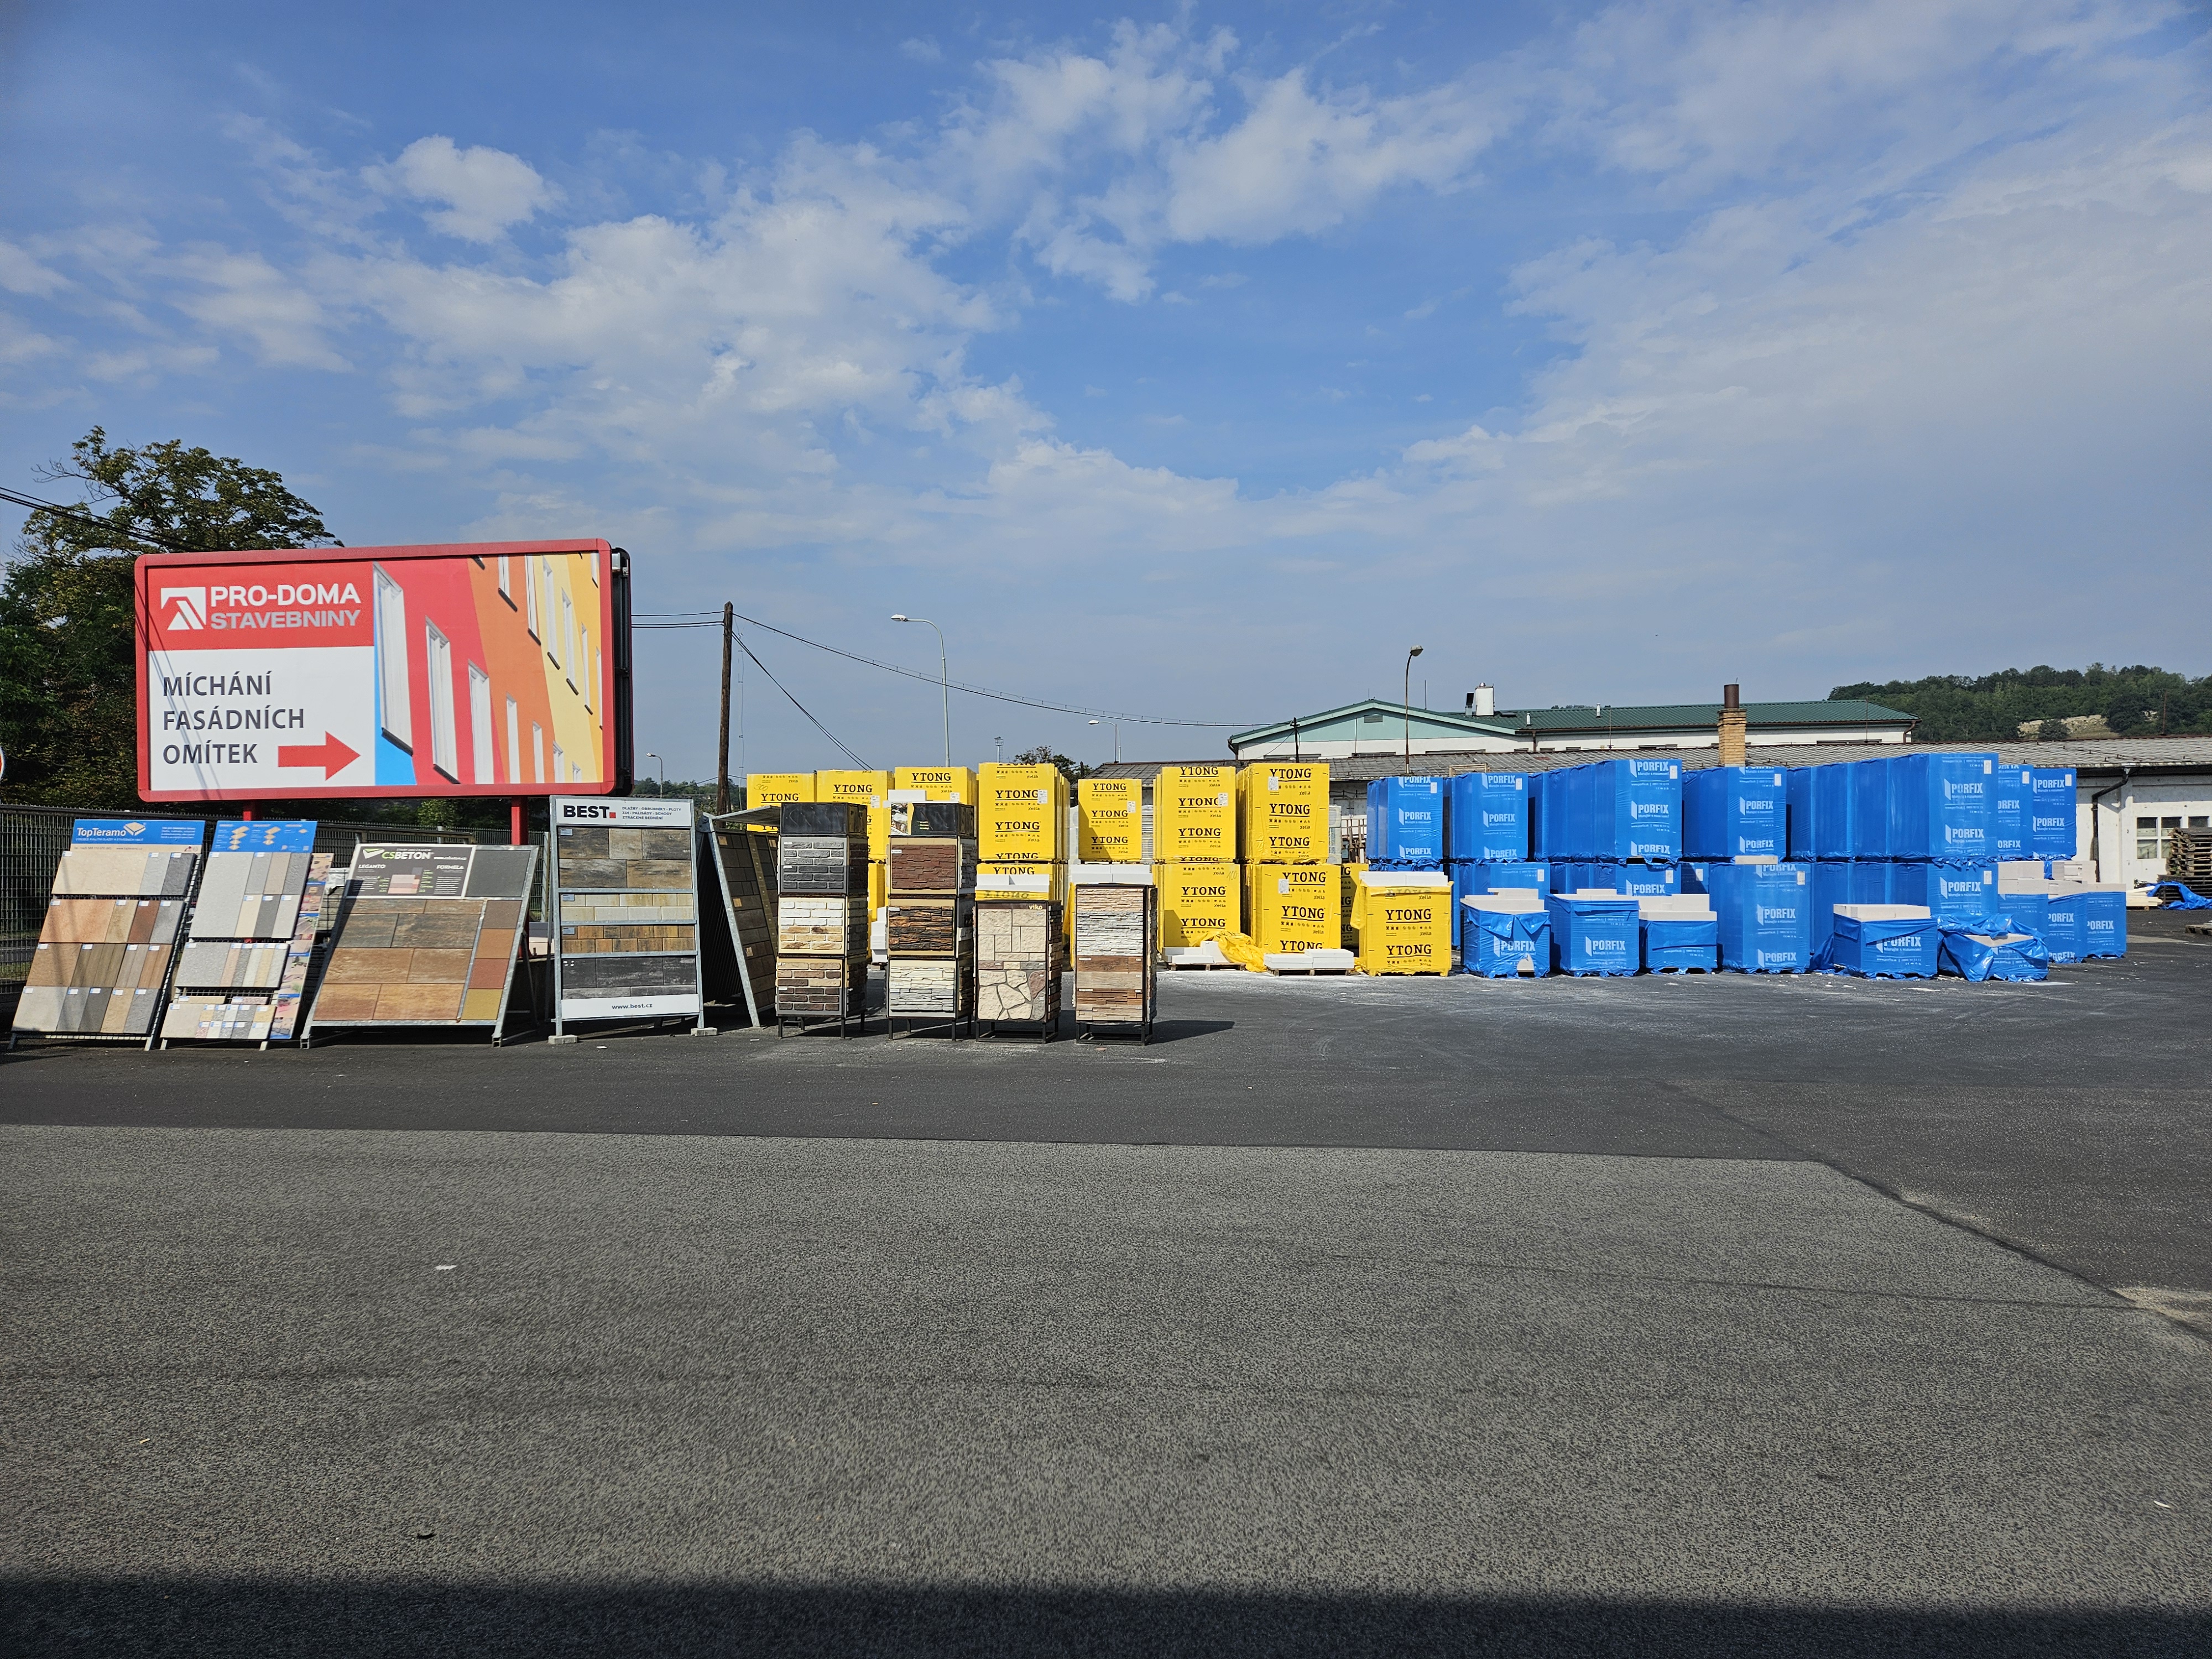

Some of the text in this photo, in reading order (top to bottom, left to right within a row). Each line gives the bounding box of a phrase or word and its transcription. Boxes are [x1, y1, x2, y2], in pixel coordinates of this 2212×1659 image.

[211, 583, 361, 607] PRO-DOMA
[211, 609, 361, 630] STAVEBNINY
[163, 670, 272, 696] MÍCHÁNÍ
[164, 705, 304, 731] FASÁDNÍCH
[163, 739, 258, 764] OMÍTEK
[1637, 761, 1669, 771] PORFIX
[1270, 768, 1311, 779] YTONG
[1488, 775, 1516, 784] PORFIX
[2038, 780, 2064, 788] PORFIX
[1952, 783, 1983, 794] PORFIX
[995, 790, 1038, 798] YTONG
[1269, 804, 1310, 815] YTONG
[1638, 804, 1669, 814] PORFIX
[1746, 801, 1773, 810] PORFIX
[1998, 800, 2020, 809] ORFIX
[1405, 812, 1431, 820] PORFIX
[1489, 814, 1515, 822] PORFIX
[995, 821, 1040, 830] YTONG
[2037, 818, 2064, 826] PORFIX
[77, 827, 126, 837] TopTeramo
[1952, 829, 1984, 838] PORFIX
[1269, 837, 1310, 846] YTONG
[1746, 840, 1774, 848] PORFIX
[1491, 849, 1517, 857] PORFIX
[1639, 844, 1671, 854] PORFIX
[1282, 872, 1326, 883] YTONG
[1181, 886, 1226, 895] YTONG
[1634, 884, 1666, 894] PORFIX
[1948, 882, 1981, 891] PORFIX
[1281, 906, 1324, 919] YTONG
[1385, 909, 1432, 920] YTONG
[1764, 909, 1796, 919] PORFIX
[1181, 919, 1225, 927] YTONG
[1280, 940, 1323, 951] YTONG
[1501, 941, 1536, 951] PORFIX
[1593, 940, 1625, 951] PORFIX
[1884, 936, 1921, 947] PORFIX
[1386, 945, 1432, 955] YTONG
[1765, 952, 1797, 962] PORFIX
